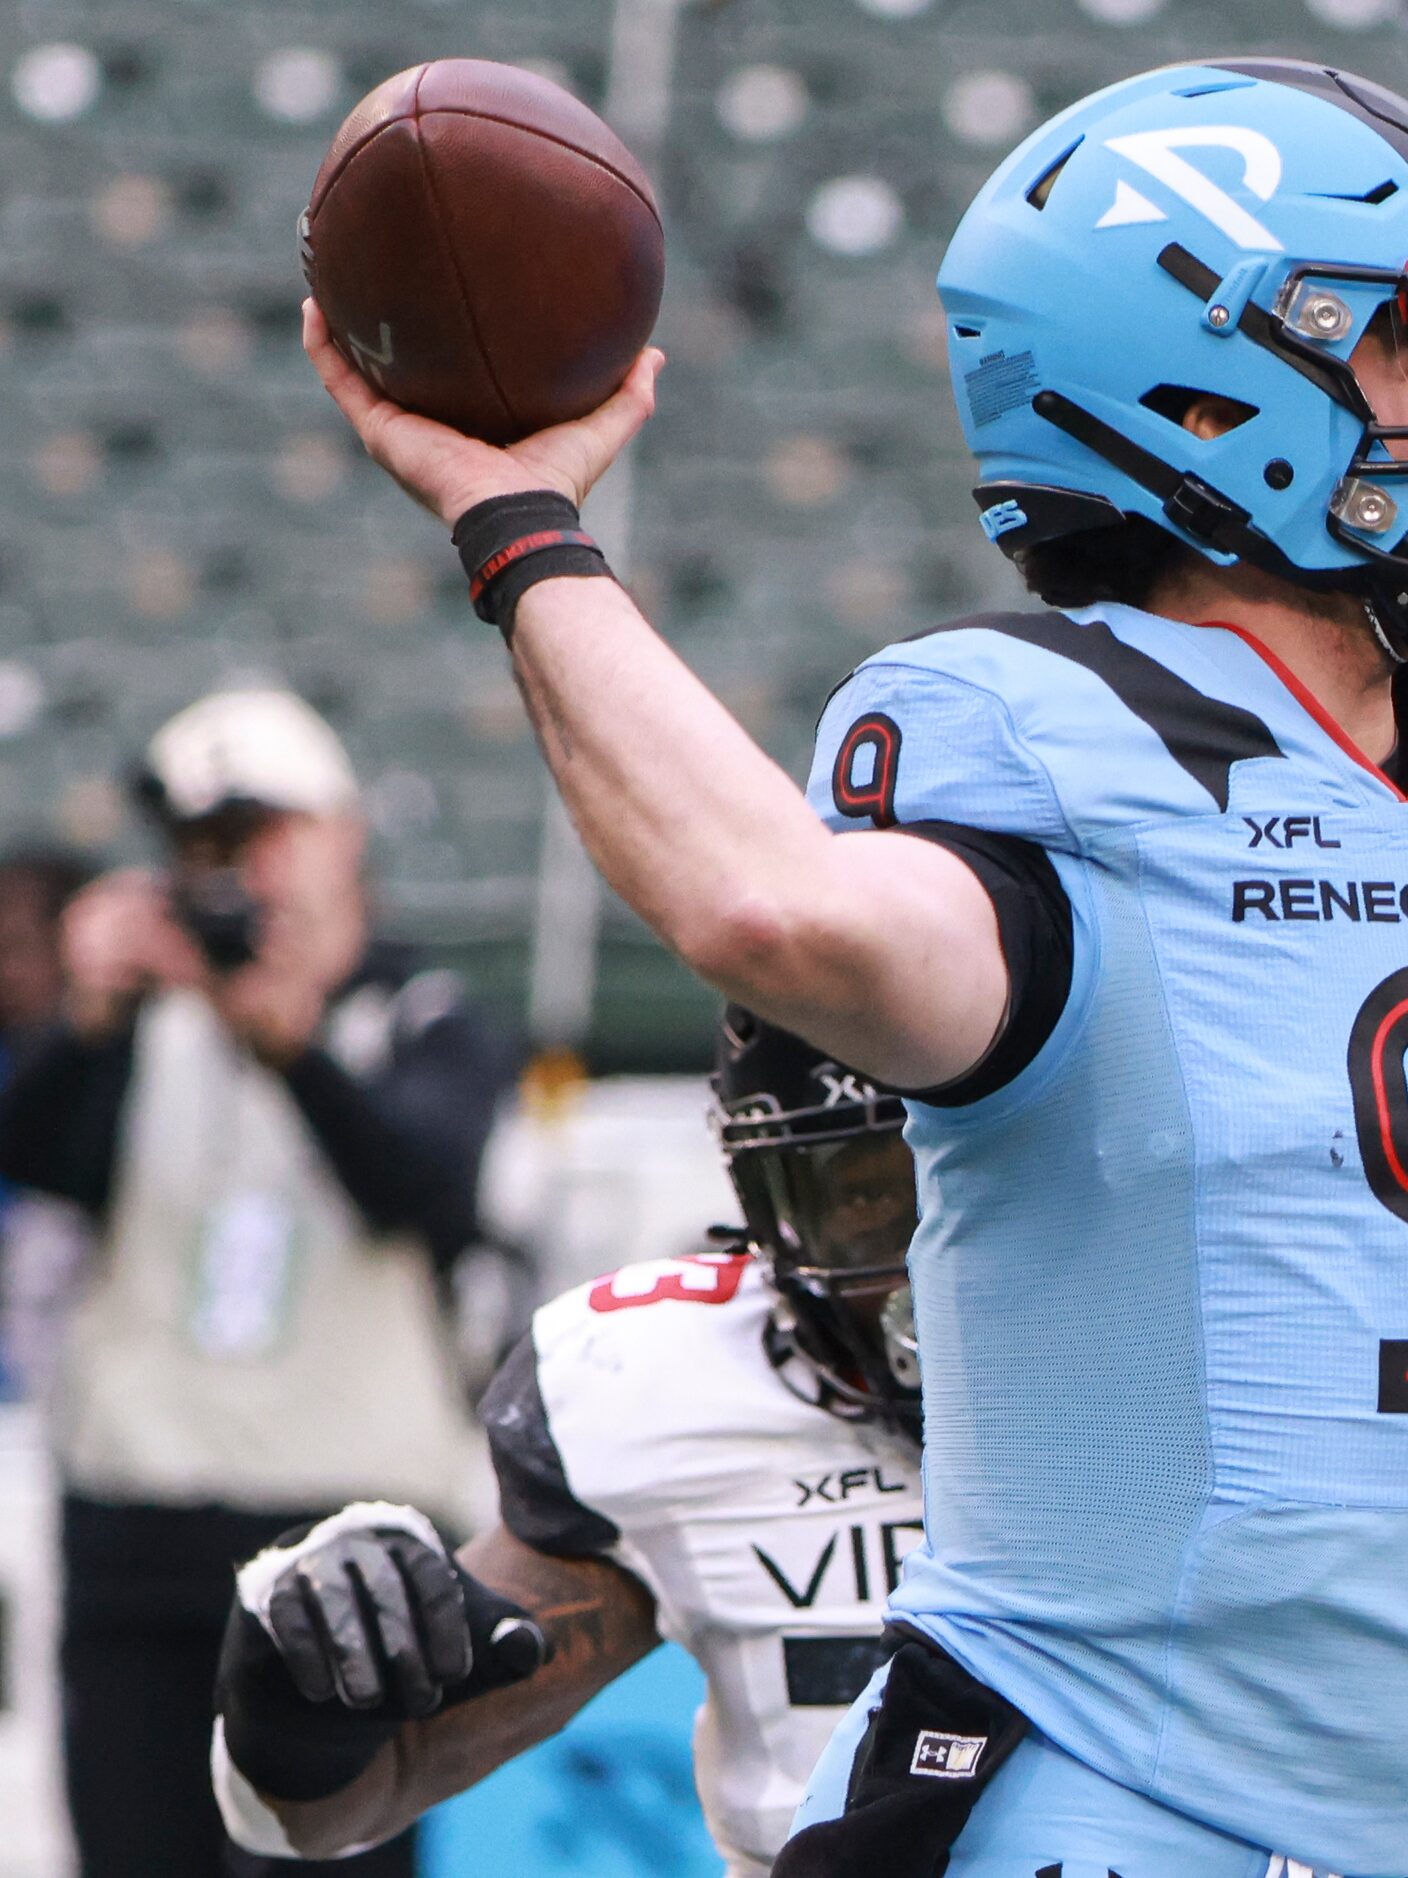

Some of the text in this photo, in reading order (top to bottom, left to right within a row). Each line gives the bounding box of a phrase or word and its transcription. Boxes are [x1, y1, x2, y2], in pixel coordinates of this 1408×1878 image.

[832, 711, 903, 829] 9
[1242, 816, 1341, 848] XFL
[793, 1467, 906, 1507] XFL
